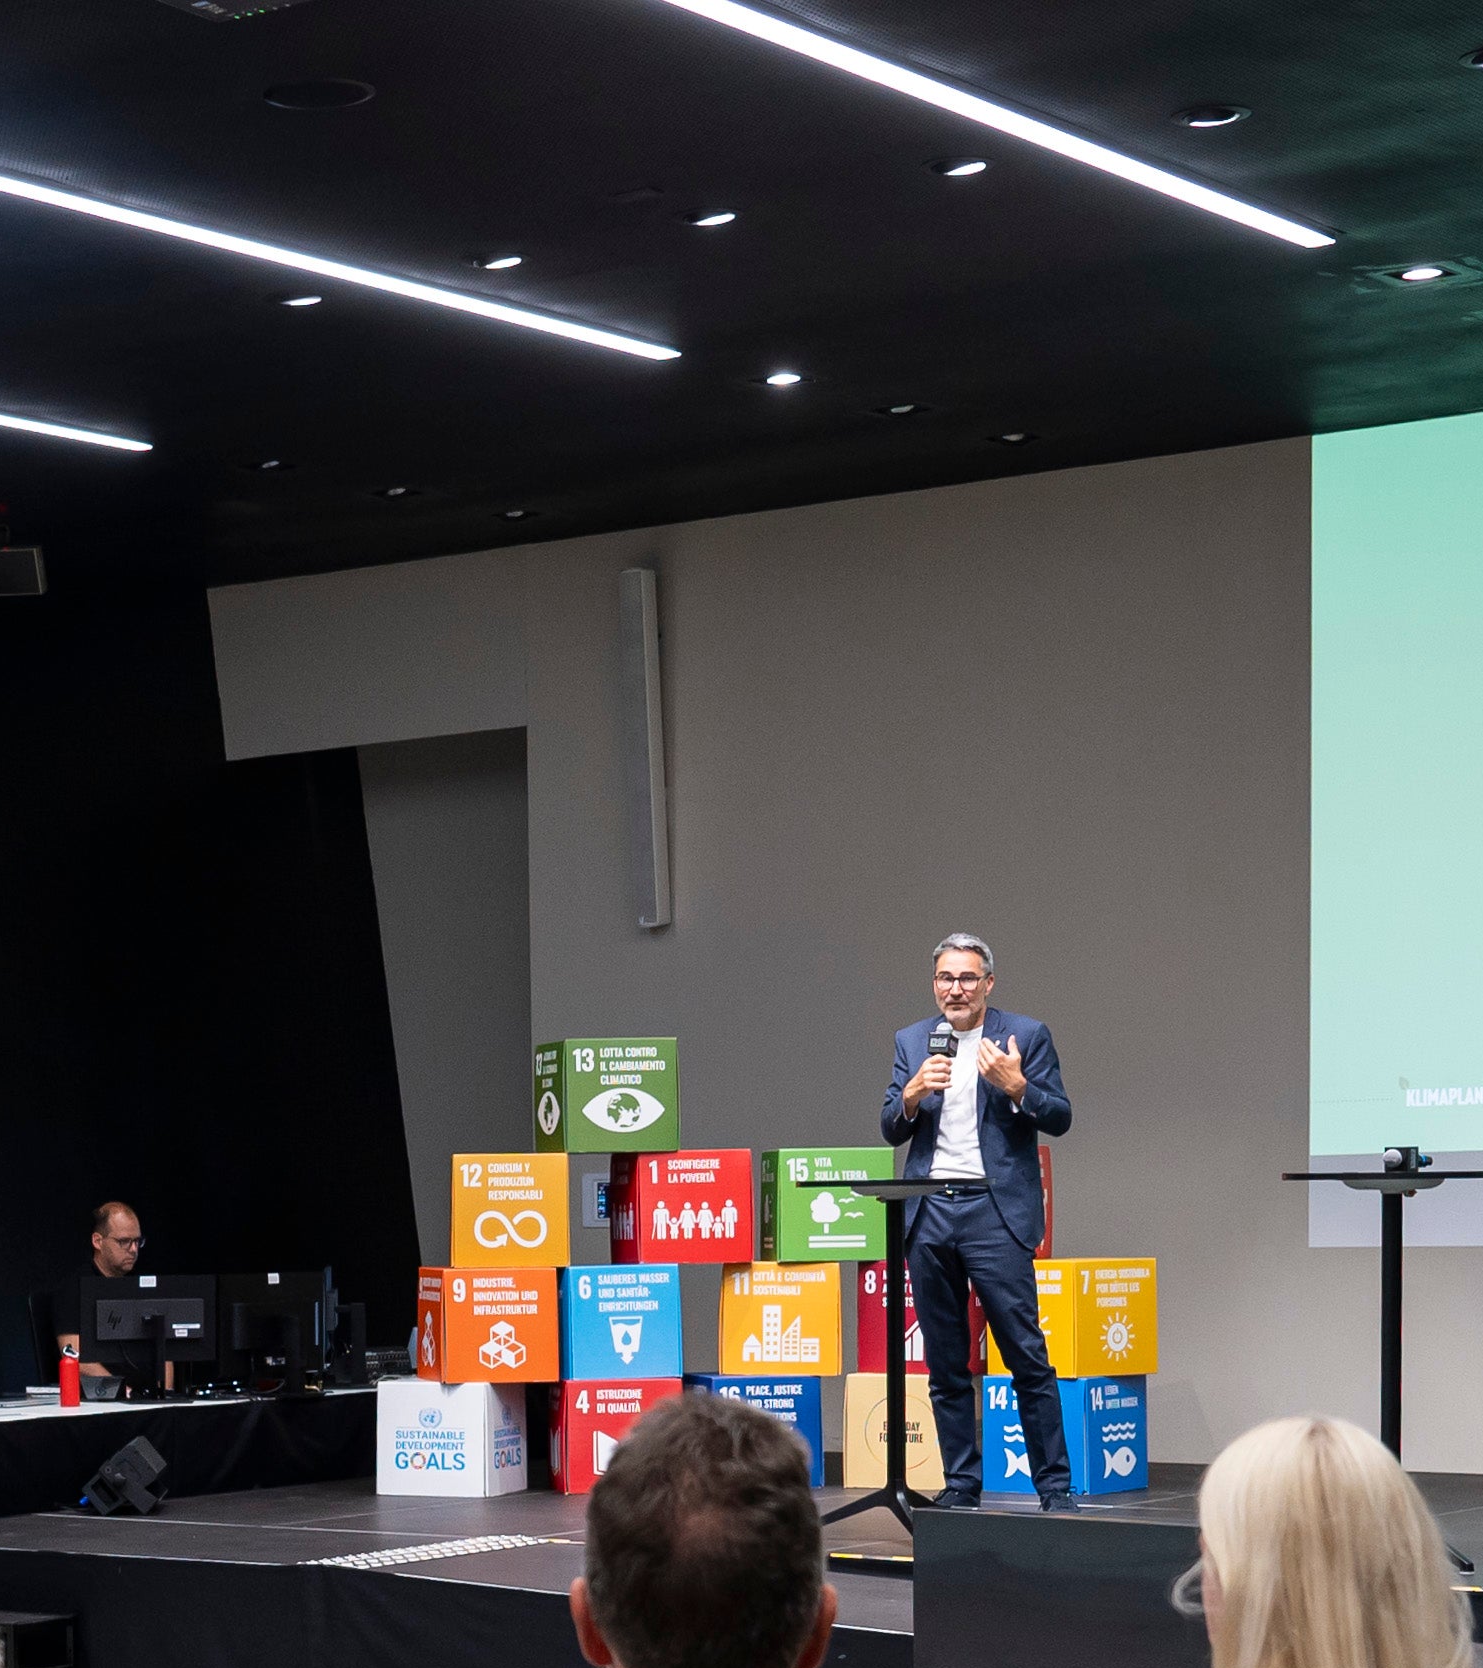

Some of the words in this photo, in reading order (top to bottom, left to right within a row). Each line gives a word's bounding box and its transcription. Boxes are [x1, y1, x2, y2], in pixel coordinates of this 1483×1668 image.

[572, 1048, 595, 1072] 13
[600, 1047, 623, 1058] LOTTA
[625, 1046, 657, 1058] CONTRO
[600, 1061, 608, 1071] IL
[609, 1060, 666, 1071] CAMBIAMENTO
[600, 1074, 642, 1085] CLIMATICO
[1406, 1087, 1483, 1107] KLIMAPLAN
[460, 1163, 483, 1187] 12
[649, 1160, 658, 1184] 1
[667, 1159, 720, 1170] SCONFIGGERE
[668, 1173, 678, 1184] LA
[680, 1170, 715, 1183] POVERTÀ
[786, 1158, 809, 1182] 15
[814, 1157, 832, 1168] VITA
[814, 1171, 840, 1181] SULLA
[841, 1170, 868, 1181] TERRA
[452, 1278, 466, 1303] 9
[473, 1277, 516, 1288] INDUSTRIE,
[578, 1275, 592, 1300] 6
[597, 1274, 636, 1285] SAUBERES
[638, 1273, 670, 1284] WASSER
[732, 1272, 750, 1295] 11
[864, 1269, 877, 1294] 8
[1080, 1270, 1090, 1295] 7
[473, 1291, 519, 1302] INNOVATION
[521, 1290, 538, 1301] UND
[598, 1288, 615, 1298] UND
[474, 1304, 538, 1316] INFRASTRUKTUR
[599, 1301, 659, 1312] EINRICHTUNGEN
[773, 1384, 803, 1396] JUSTICE
[987, 1385, 1008, 1410] 14
[1090, 1386, 1104, 1412] 14
[575, 1390, 590, 1414] 4
[596, 1388, 642, 1400] ISTRUZIONE
[596, 1403, 606, 1413] DI
[607, 1400, 641, 1414] QUALITÀ
[763, 1398, 794, 1409] STRONG
[395, 1430, 465, 1440] SUSTAINABLE
[395, 1441, 465, 1451] DEVELOPMENT
[395, 1451, 465, 1470] GOALS
[494, 1448, 521, 1469] GOALS
